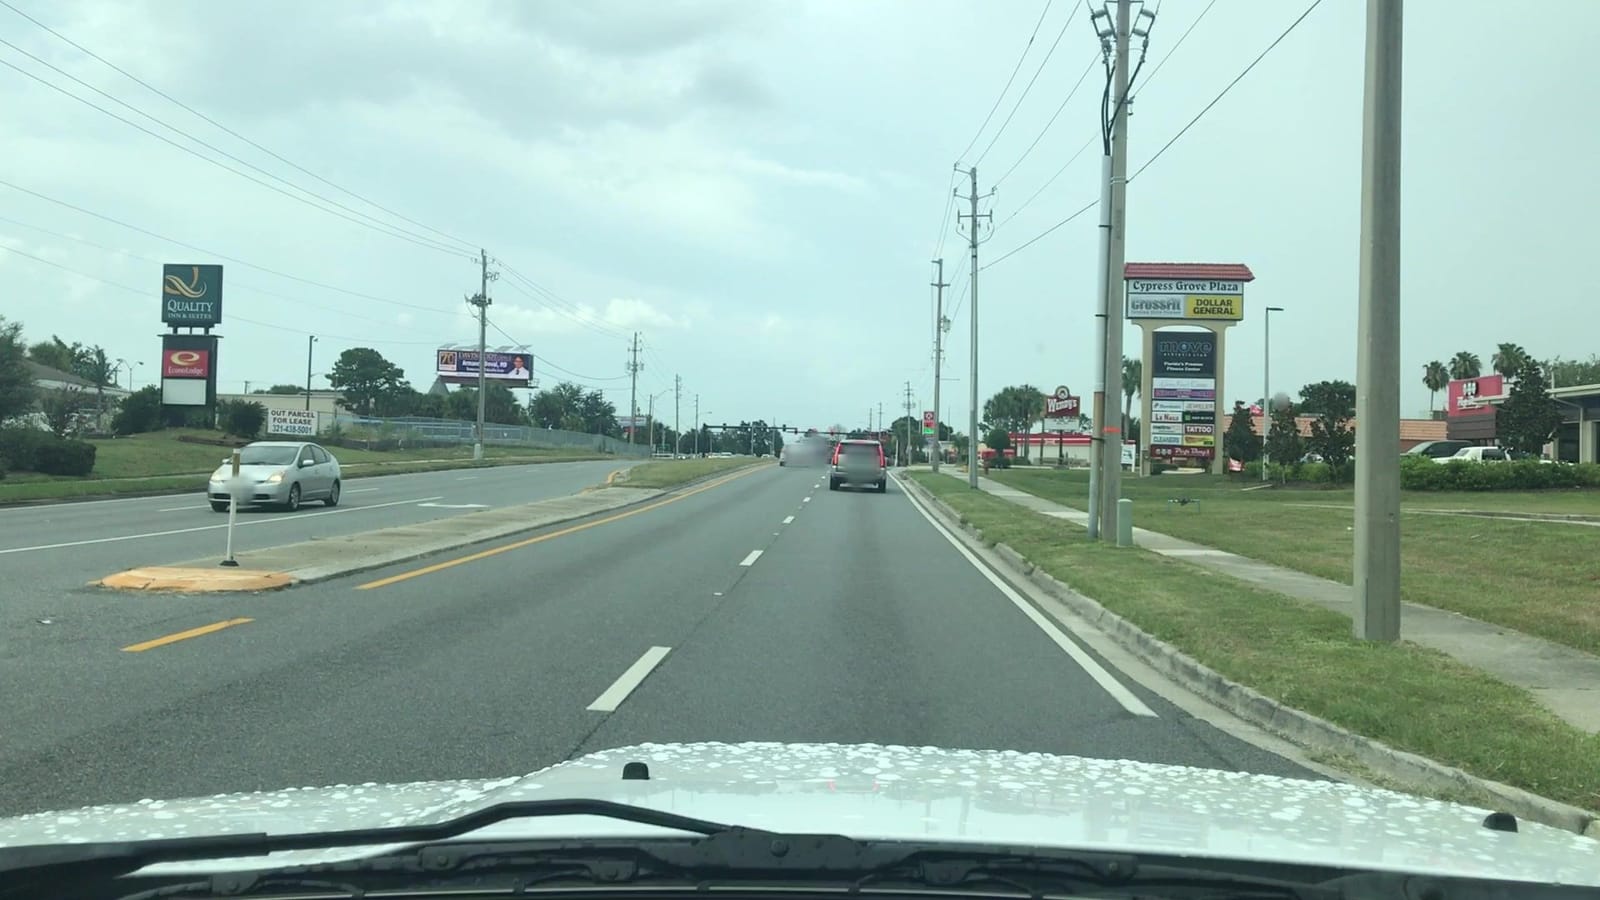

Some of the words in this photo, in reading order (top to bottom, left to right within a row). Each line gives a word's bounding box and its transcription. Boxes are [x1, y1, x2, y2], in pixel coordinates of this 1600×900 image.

[1133, 281, 1173, 291] Cypress
[1176, 281, 1207, 290] Grove
[1209, 281, 1239, 291] Plaza
[168, 299, 213, 312] QUALITY
[1193, 306, 1235, 315] GENERAL
[1160, 341, 1212, 353] move
[1047, 399, 1078, 412] Wendy's
